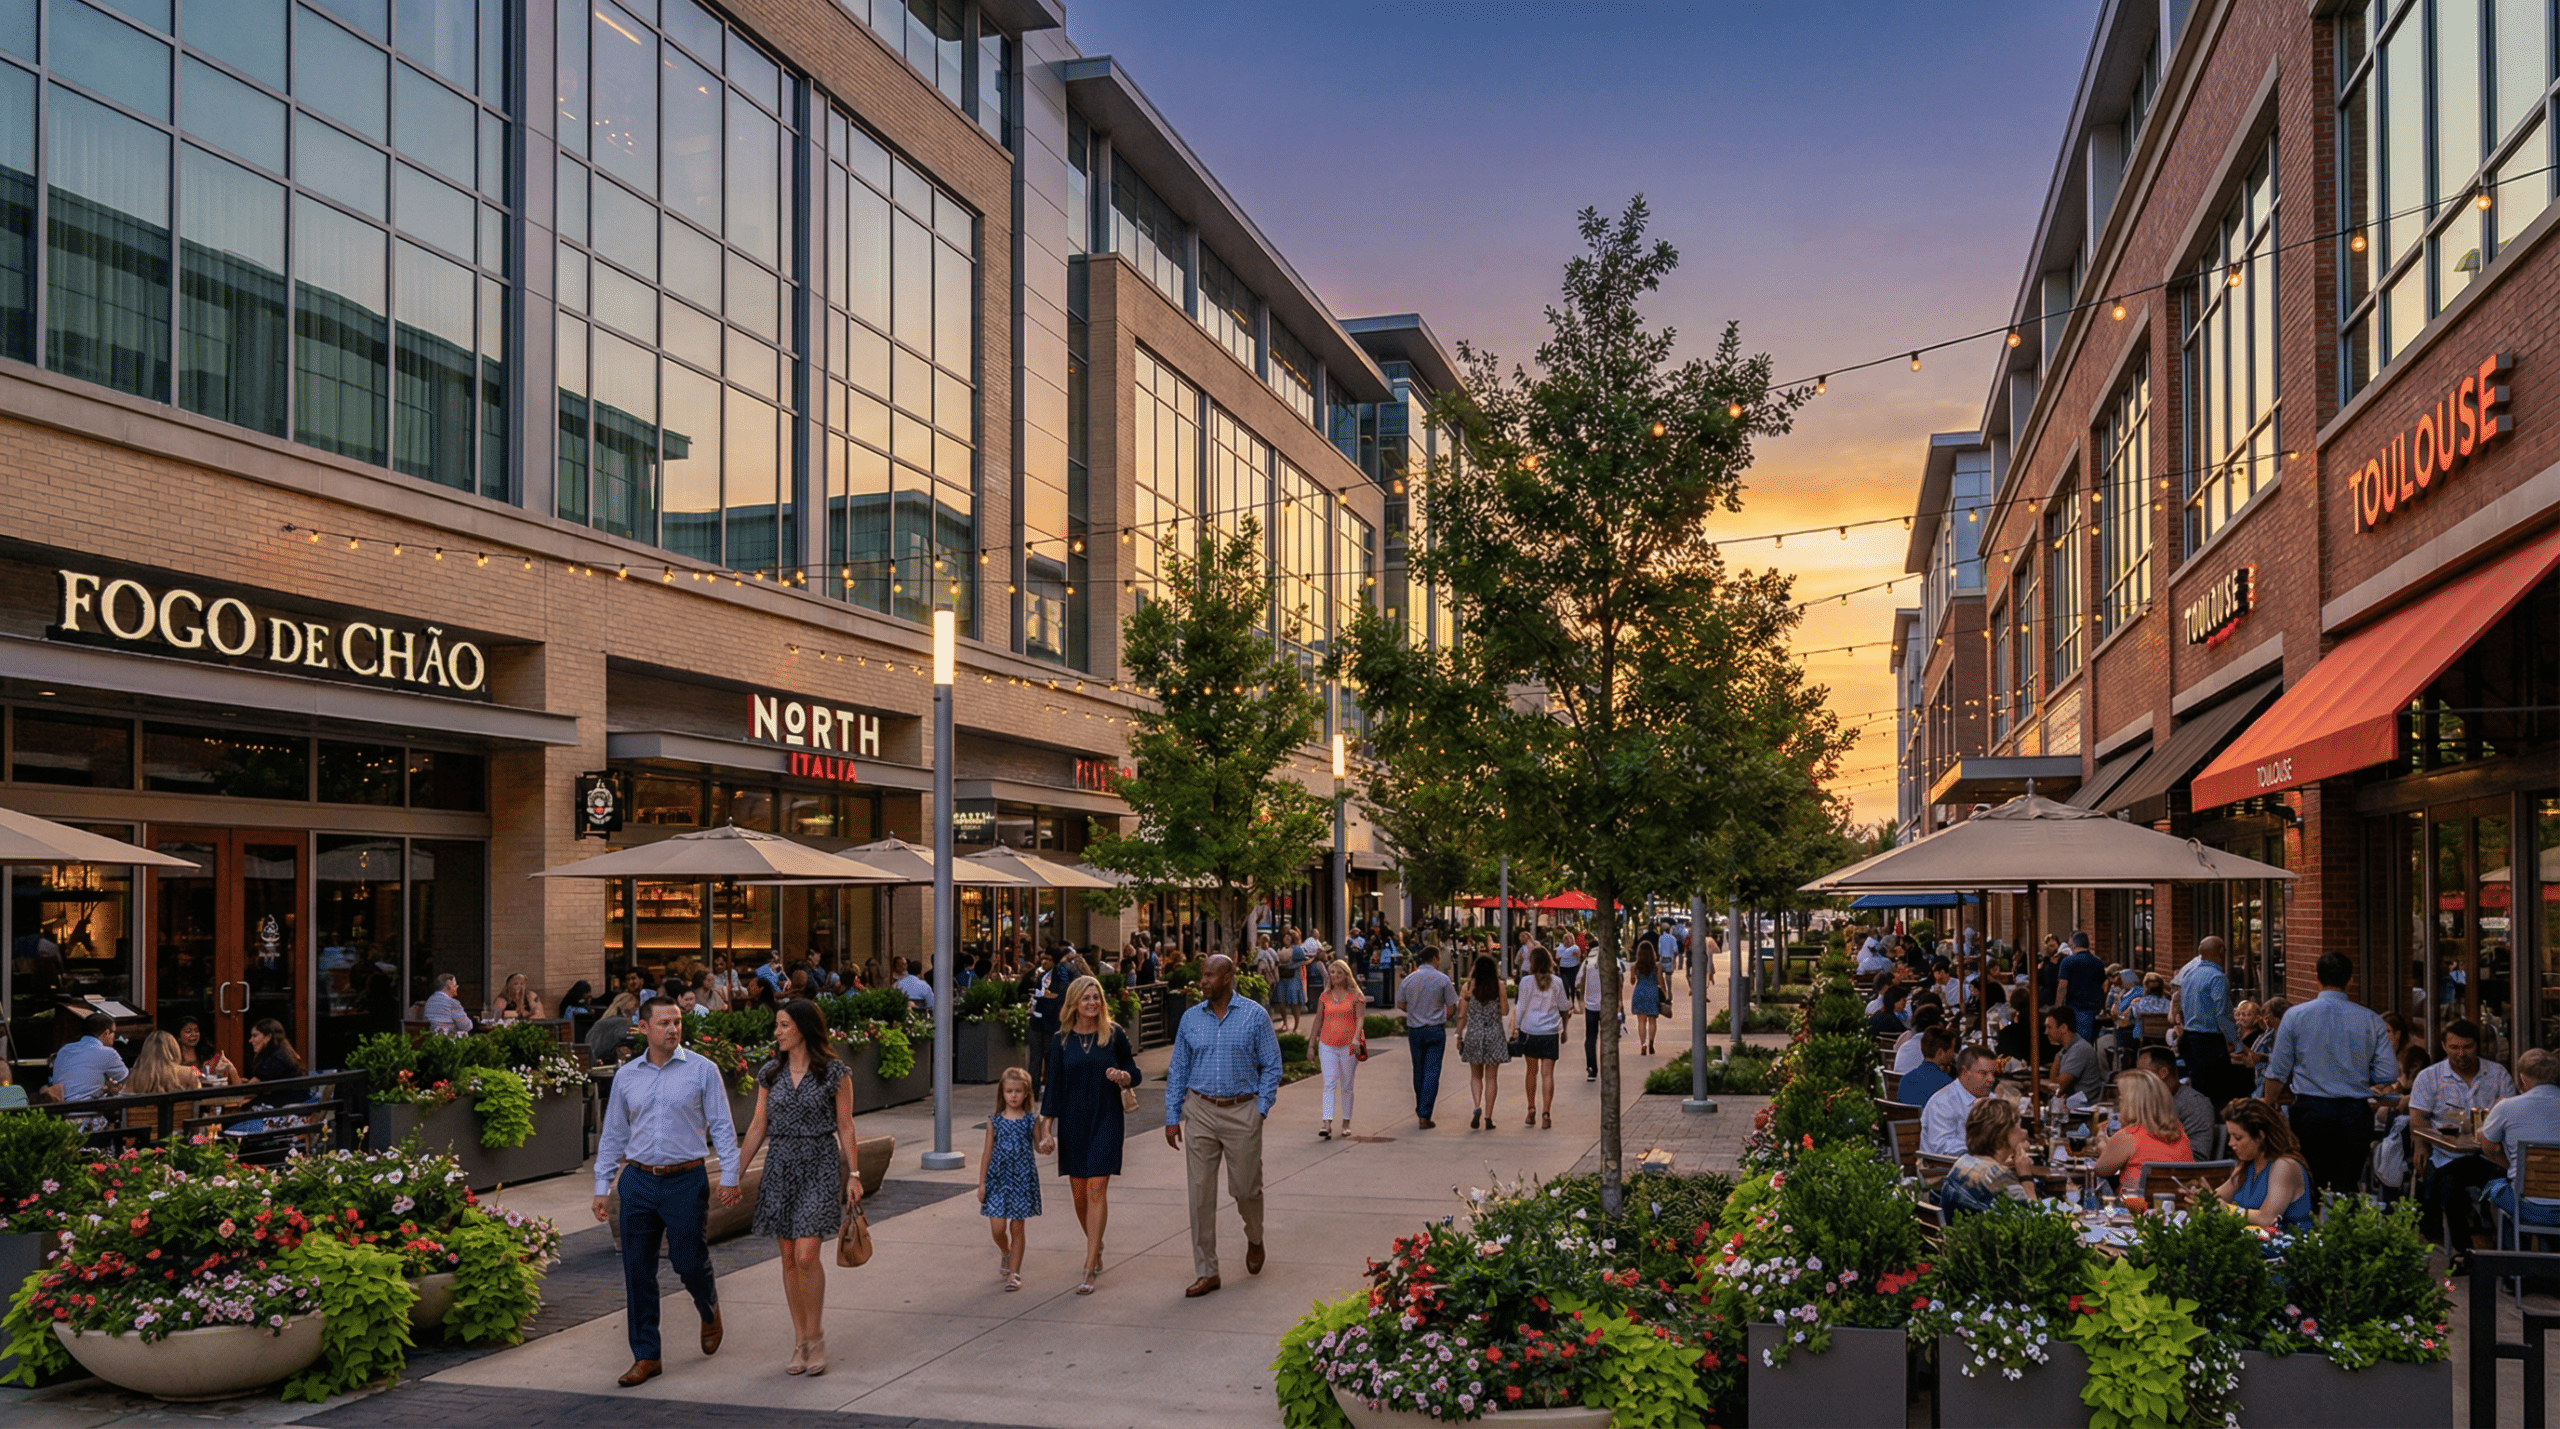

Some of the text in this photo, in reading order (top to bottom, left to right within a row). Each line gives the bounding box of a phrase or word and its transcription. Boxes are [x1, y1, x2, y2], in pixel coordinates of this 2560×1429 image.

[2348, 353, 2498, 535] TOULOUSE
[58, 569, 485, 691] FOGO DE CHÃO
[2184, 569, 2240, 646] TOULOUSE
[752, 693, 879, 757] NORTH
[790, 751, 858, 784] ITALIA
[2256, 757, 2292, 789] TOULOUSE
